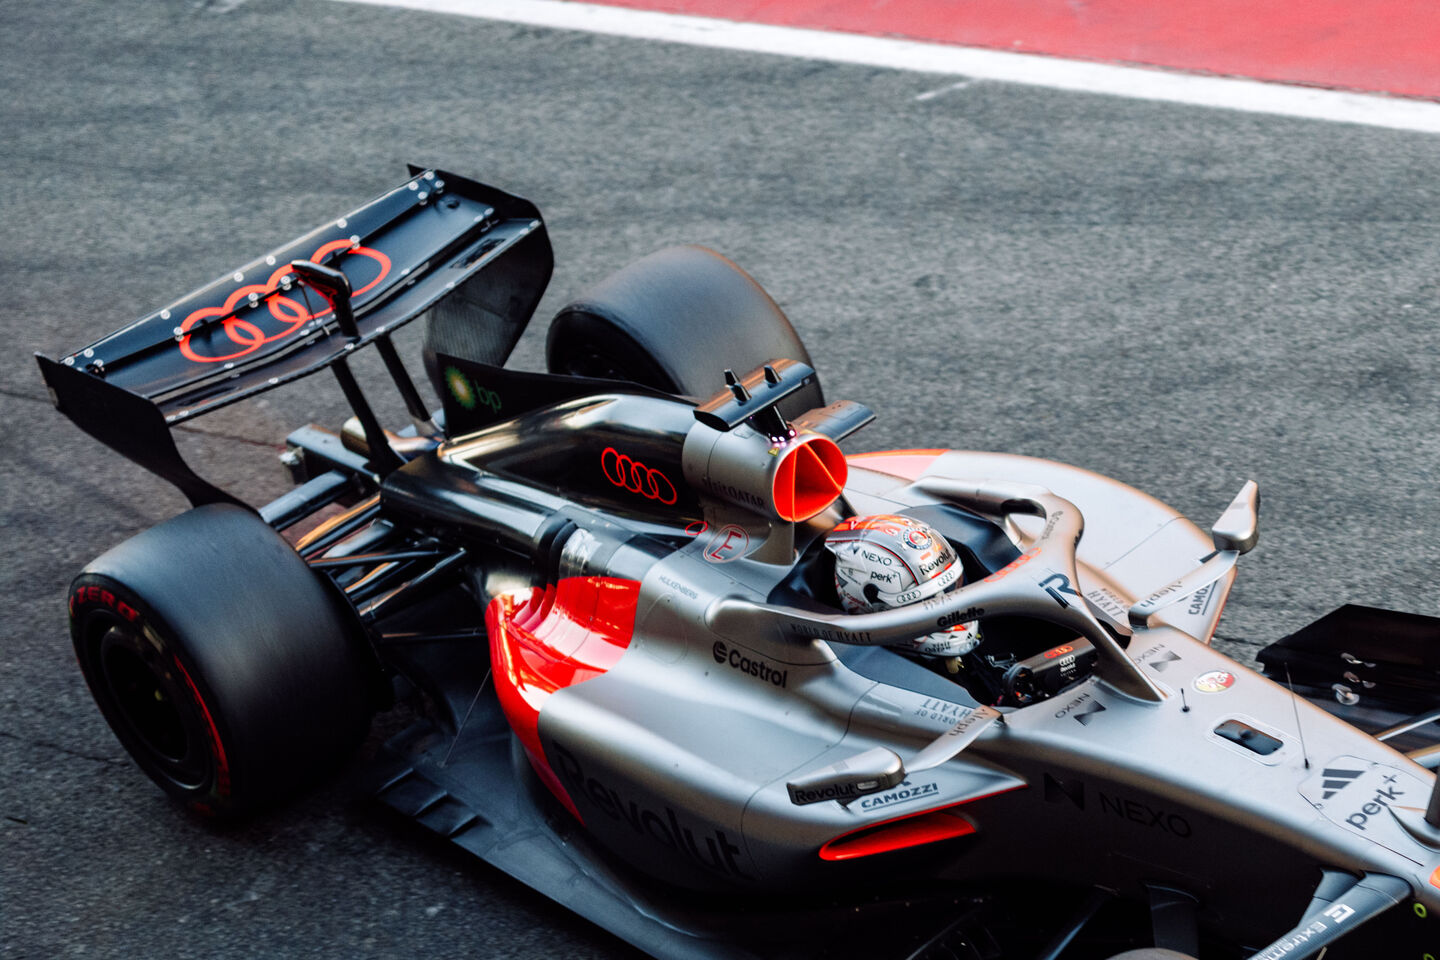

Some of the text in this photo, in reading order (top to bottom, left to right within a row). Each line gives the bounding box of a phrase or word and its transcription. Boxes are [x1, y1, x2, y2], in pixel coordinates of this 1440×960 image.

[473, 379, 502, 414] bp
[711, 529, 742, 560] E
[861, 550, 892, 566] NEXO
[76, 586, 139, 621] ZERO
[1038, 573, 1082, 609] R
[1086, 590, 1126, 617] HYATT
[1188, 584, 1210, 615] CAMO
[937, 607, 985, 627] Gillette
[836, 630, 872, 643] HYATT
[729, 649, 788, 688] Castrol
[914, 709, 959, 725] ORLD OF
[921, 698, 973, 719] HYATT
[1054, 693, 1090, 719] NEXO
[795, 782, 857, 803] Revolut
[861, 782, 938, 809] CAMOZZI
[552, 740, 762, 881] Revolut
[1099, 791, 1192, 838] NEXO
